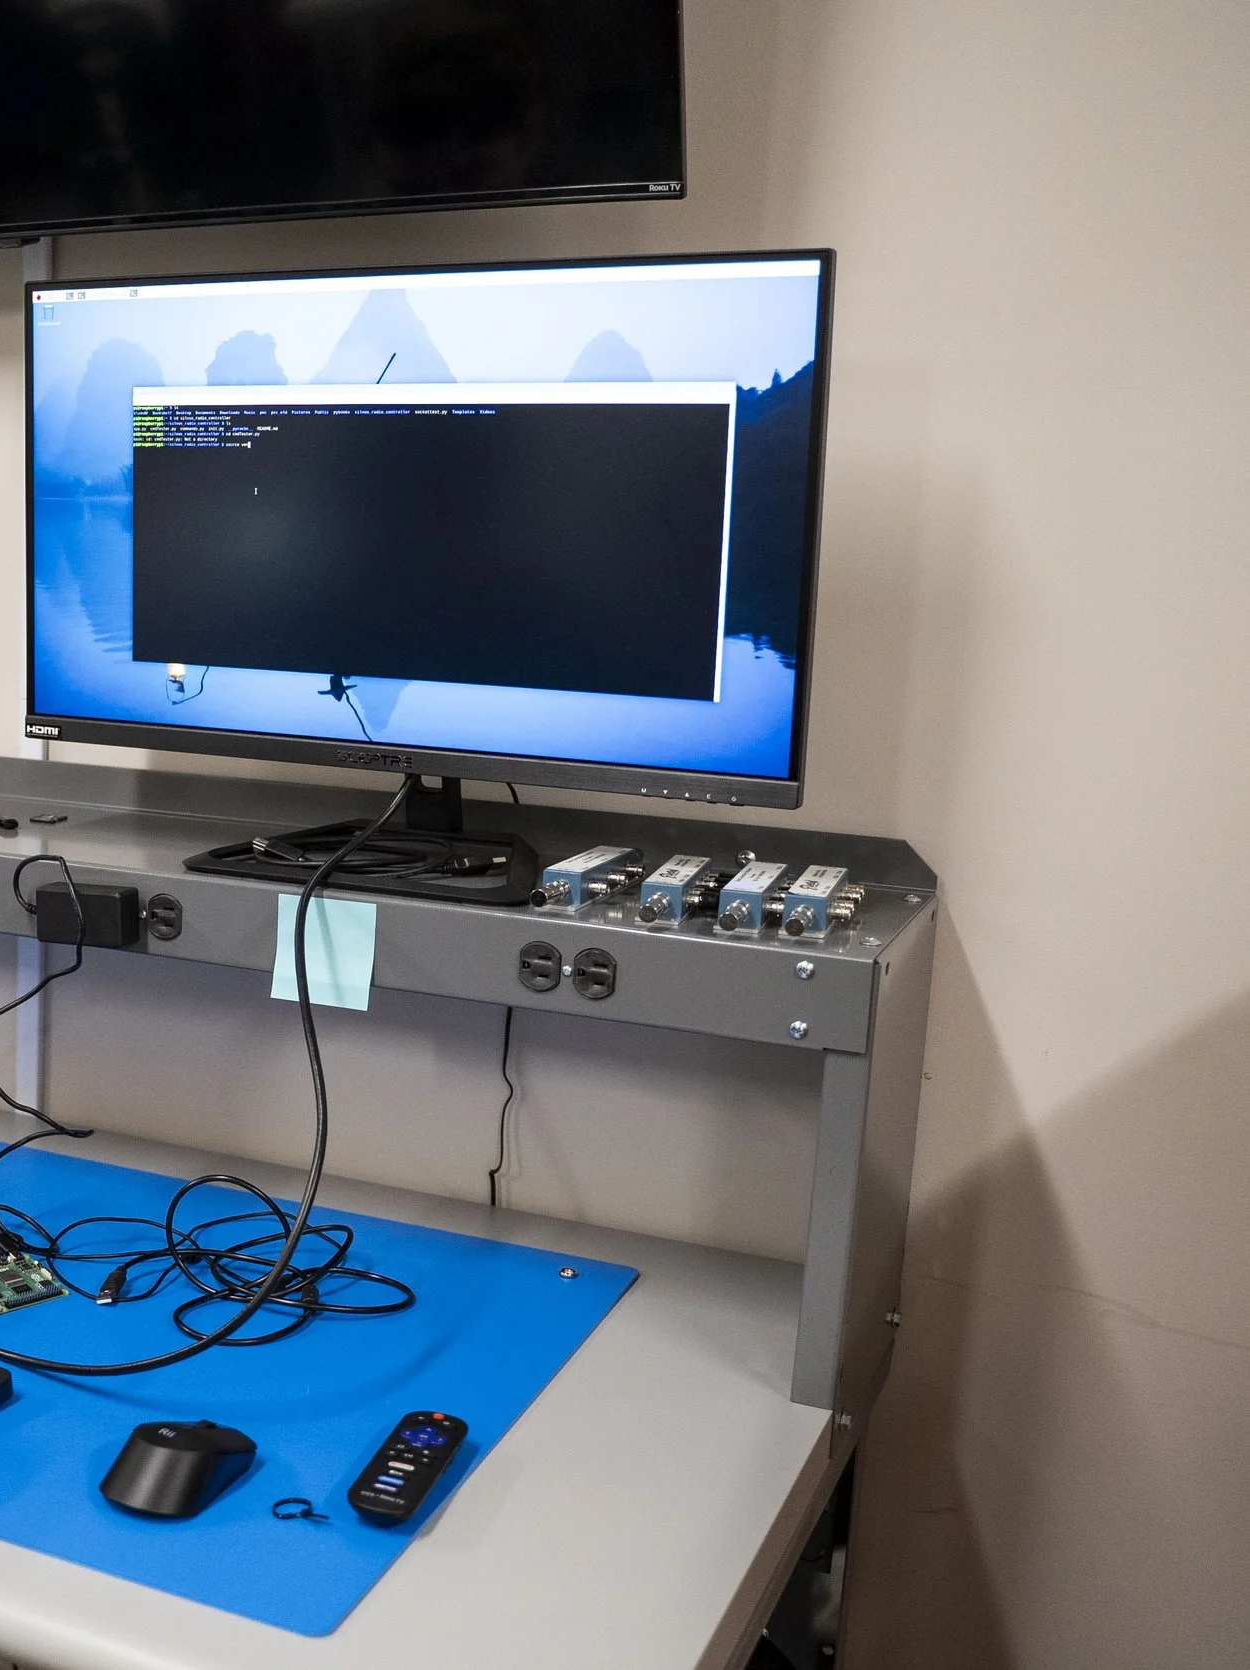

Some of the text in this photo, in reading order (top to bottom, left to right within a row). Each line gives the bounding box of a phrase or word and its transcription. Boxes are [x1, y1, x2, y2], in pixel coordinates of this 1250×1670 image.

[649, 183, 681, 192] Roku TV
[26, 725, 59, 736] HDMI
[336, 749, 414, 769] SCEPTRE
[158, 1428, 176, 1438] Rii
